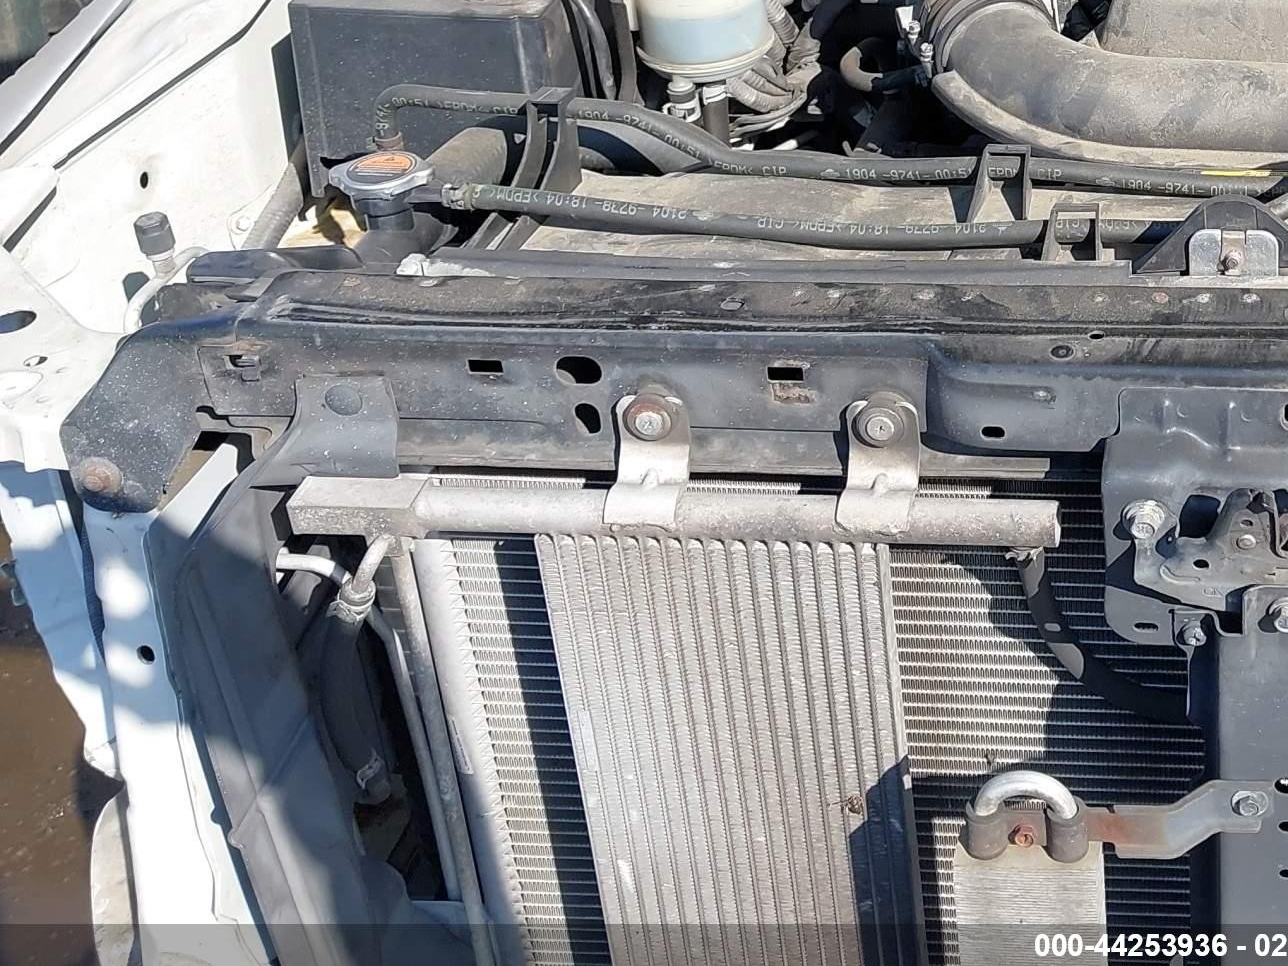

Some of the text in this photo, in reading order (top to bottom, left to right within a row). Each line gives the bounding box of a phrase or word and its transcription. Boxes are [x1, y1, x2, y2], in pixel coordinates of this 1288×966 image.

[846, 168, 877, 180] 1904
[882, 170, 929, 181] -9741-
[489, 188, 538, 203] >EPDM<
[545, 194, 587, 208] 18:04
